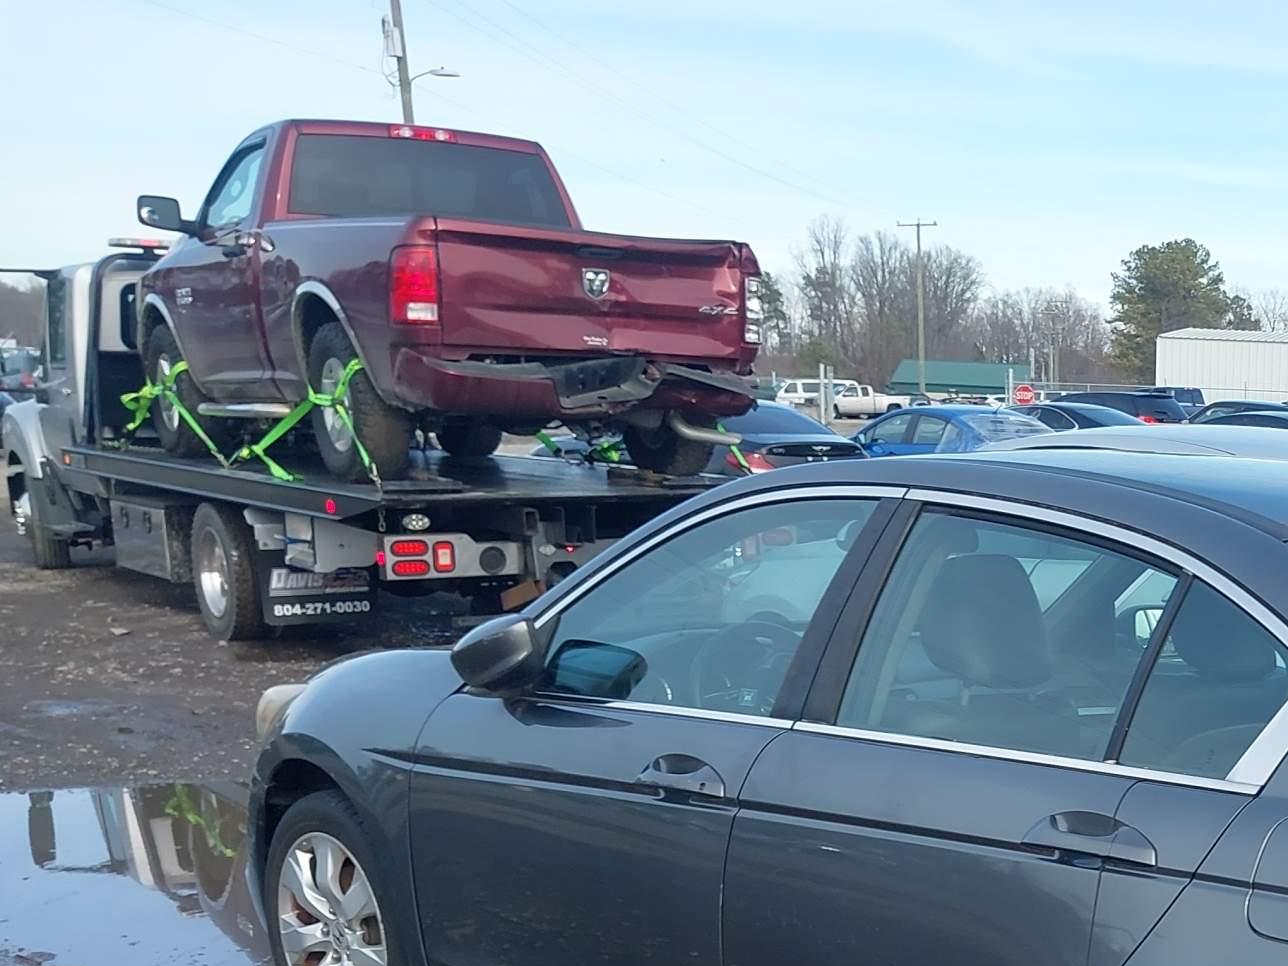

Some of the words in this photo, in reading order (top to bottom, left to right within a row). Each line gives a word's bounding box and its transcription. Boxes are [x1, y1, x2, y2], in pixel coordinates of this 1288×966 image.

[1016, 391, 1033, 400] STOP
[271, 569, 324, 590] DAVIS
[273, 601, 371, 617] 804-271-0030
